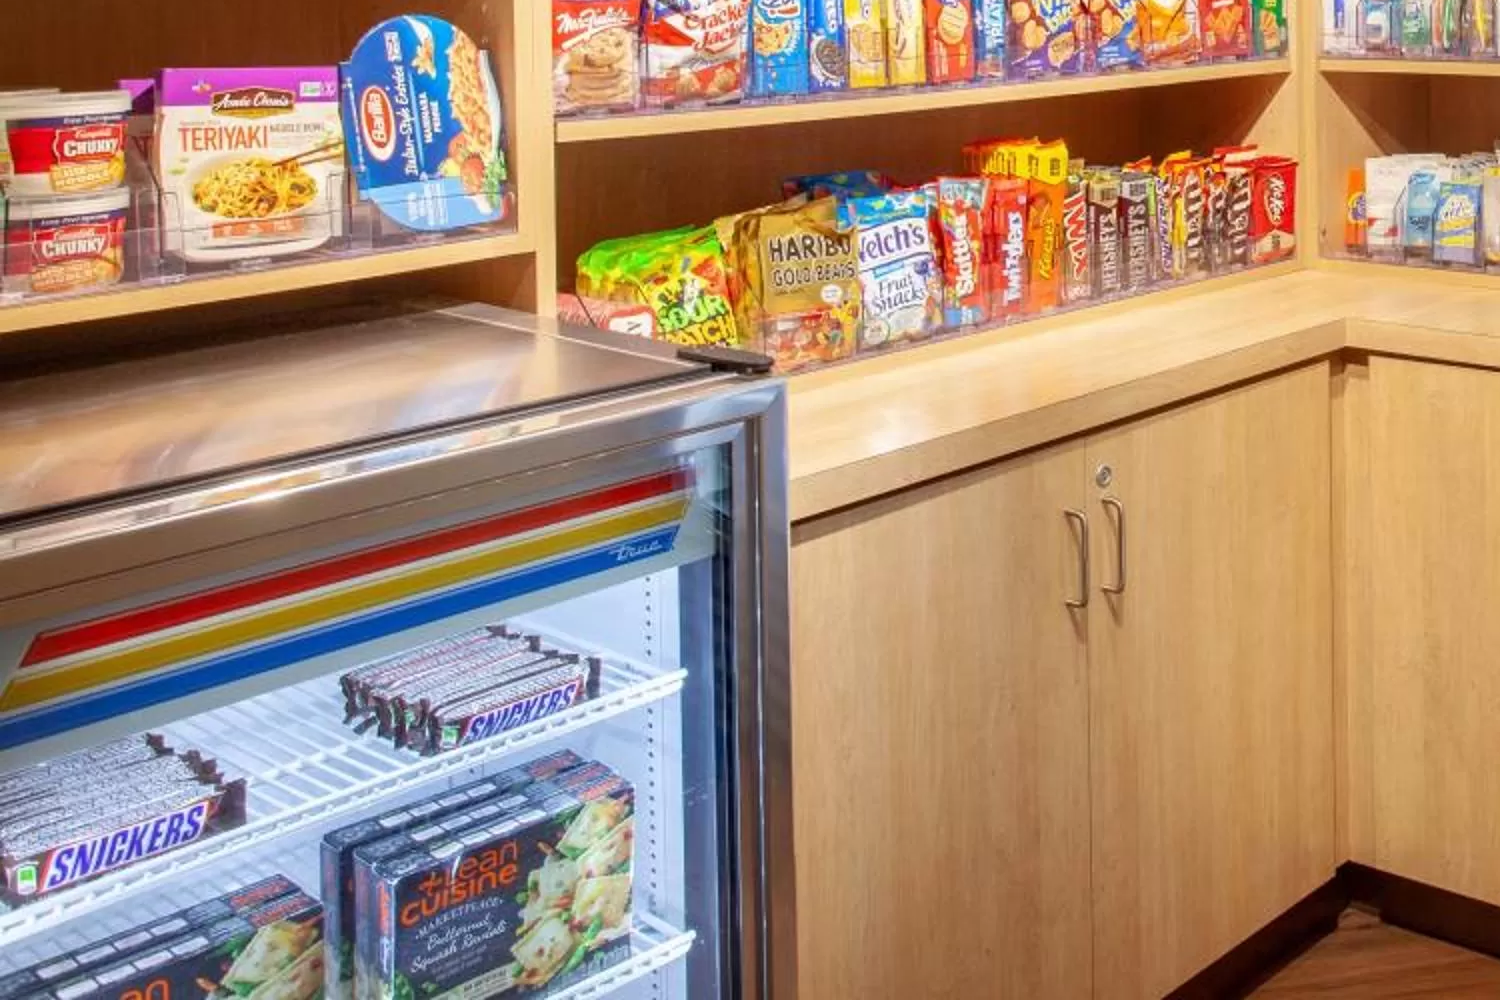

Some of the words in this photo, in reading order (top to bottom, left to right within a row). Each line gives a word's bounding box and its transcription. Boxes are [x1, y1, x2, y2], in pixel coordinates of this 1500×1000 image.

[178, 123, 270, 152] TERIYAKI
[366, 92, 388, 143] Barilla
[63, 138, 119, 157] CHUNKY
[42, 236, 106, 257] CHUNKY
[768, 234, 852, 262] HARIBO
[953, 213, 975, 298] Skittles
[466, 681, 577, 741] SNICKERS
[50, 804, 206, 887] SNICKERS
[400, 862, 519, 928] cuisine
